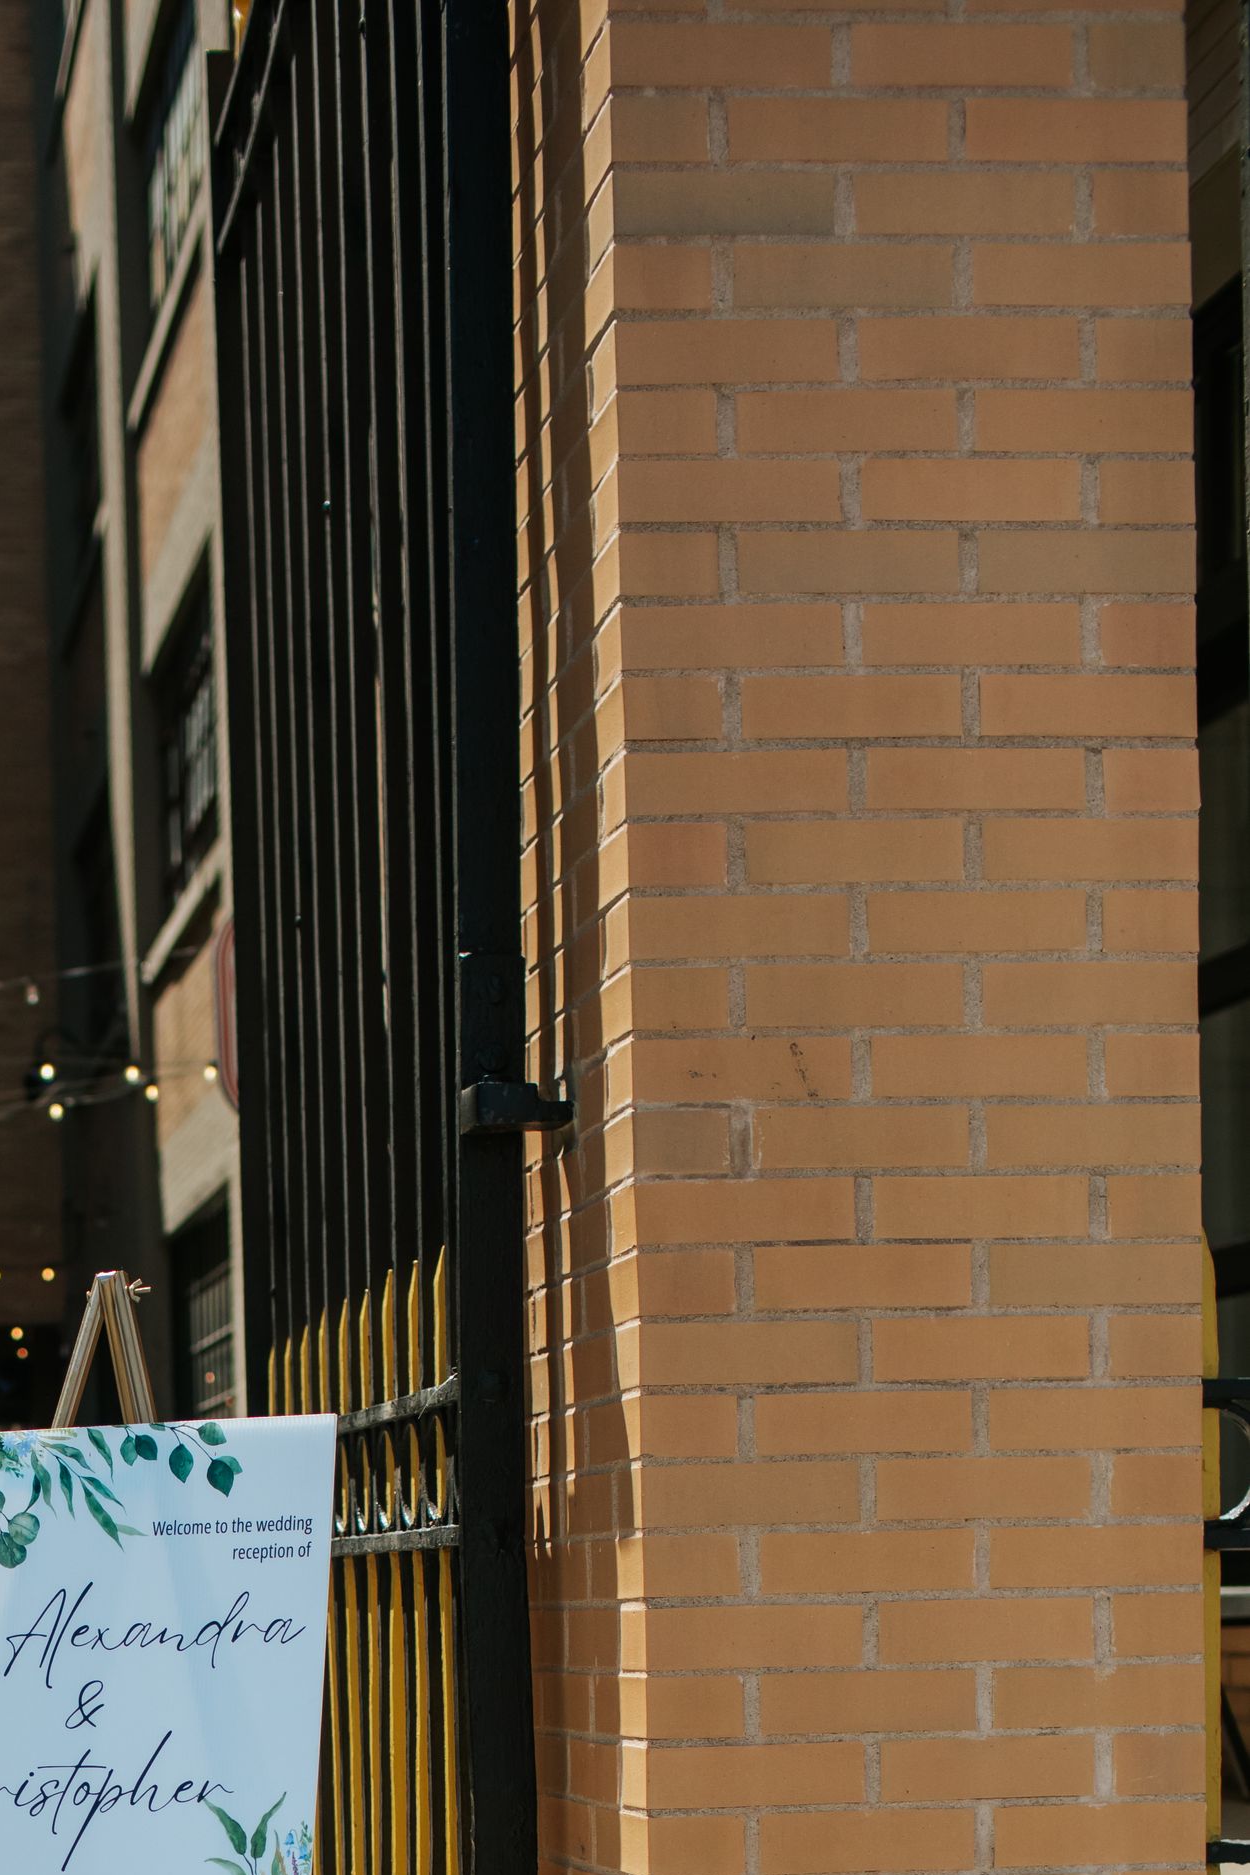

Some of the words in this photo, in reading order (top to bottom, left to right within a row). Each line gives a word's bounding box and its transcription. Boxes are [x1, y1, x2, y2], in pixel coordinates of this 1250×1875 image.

[152, 1519, 212, 1537] Welcome
[215, 1520, 228, 1534] to
[231, 1518, 253, 1534] the
[255, 1515, 313, 1535] wedding
[233, 1544, 294, 1563] reception
[298, 1541, 312, 1559] of
[4, 1582, 307, 1689] Alexandra
[65, 1680, 104, 1729] &
